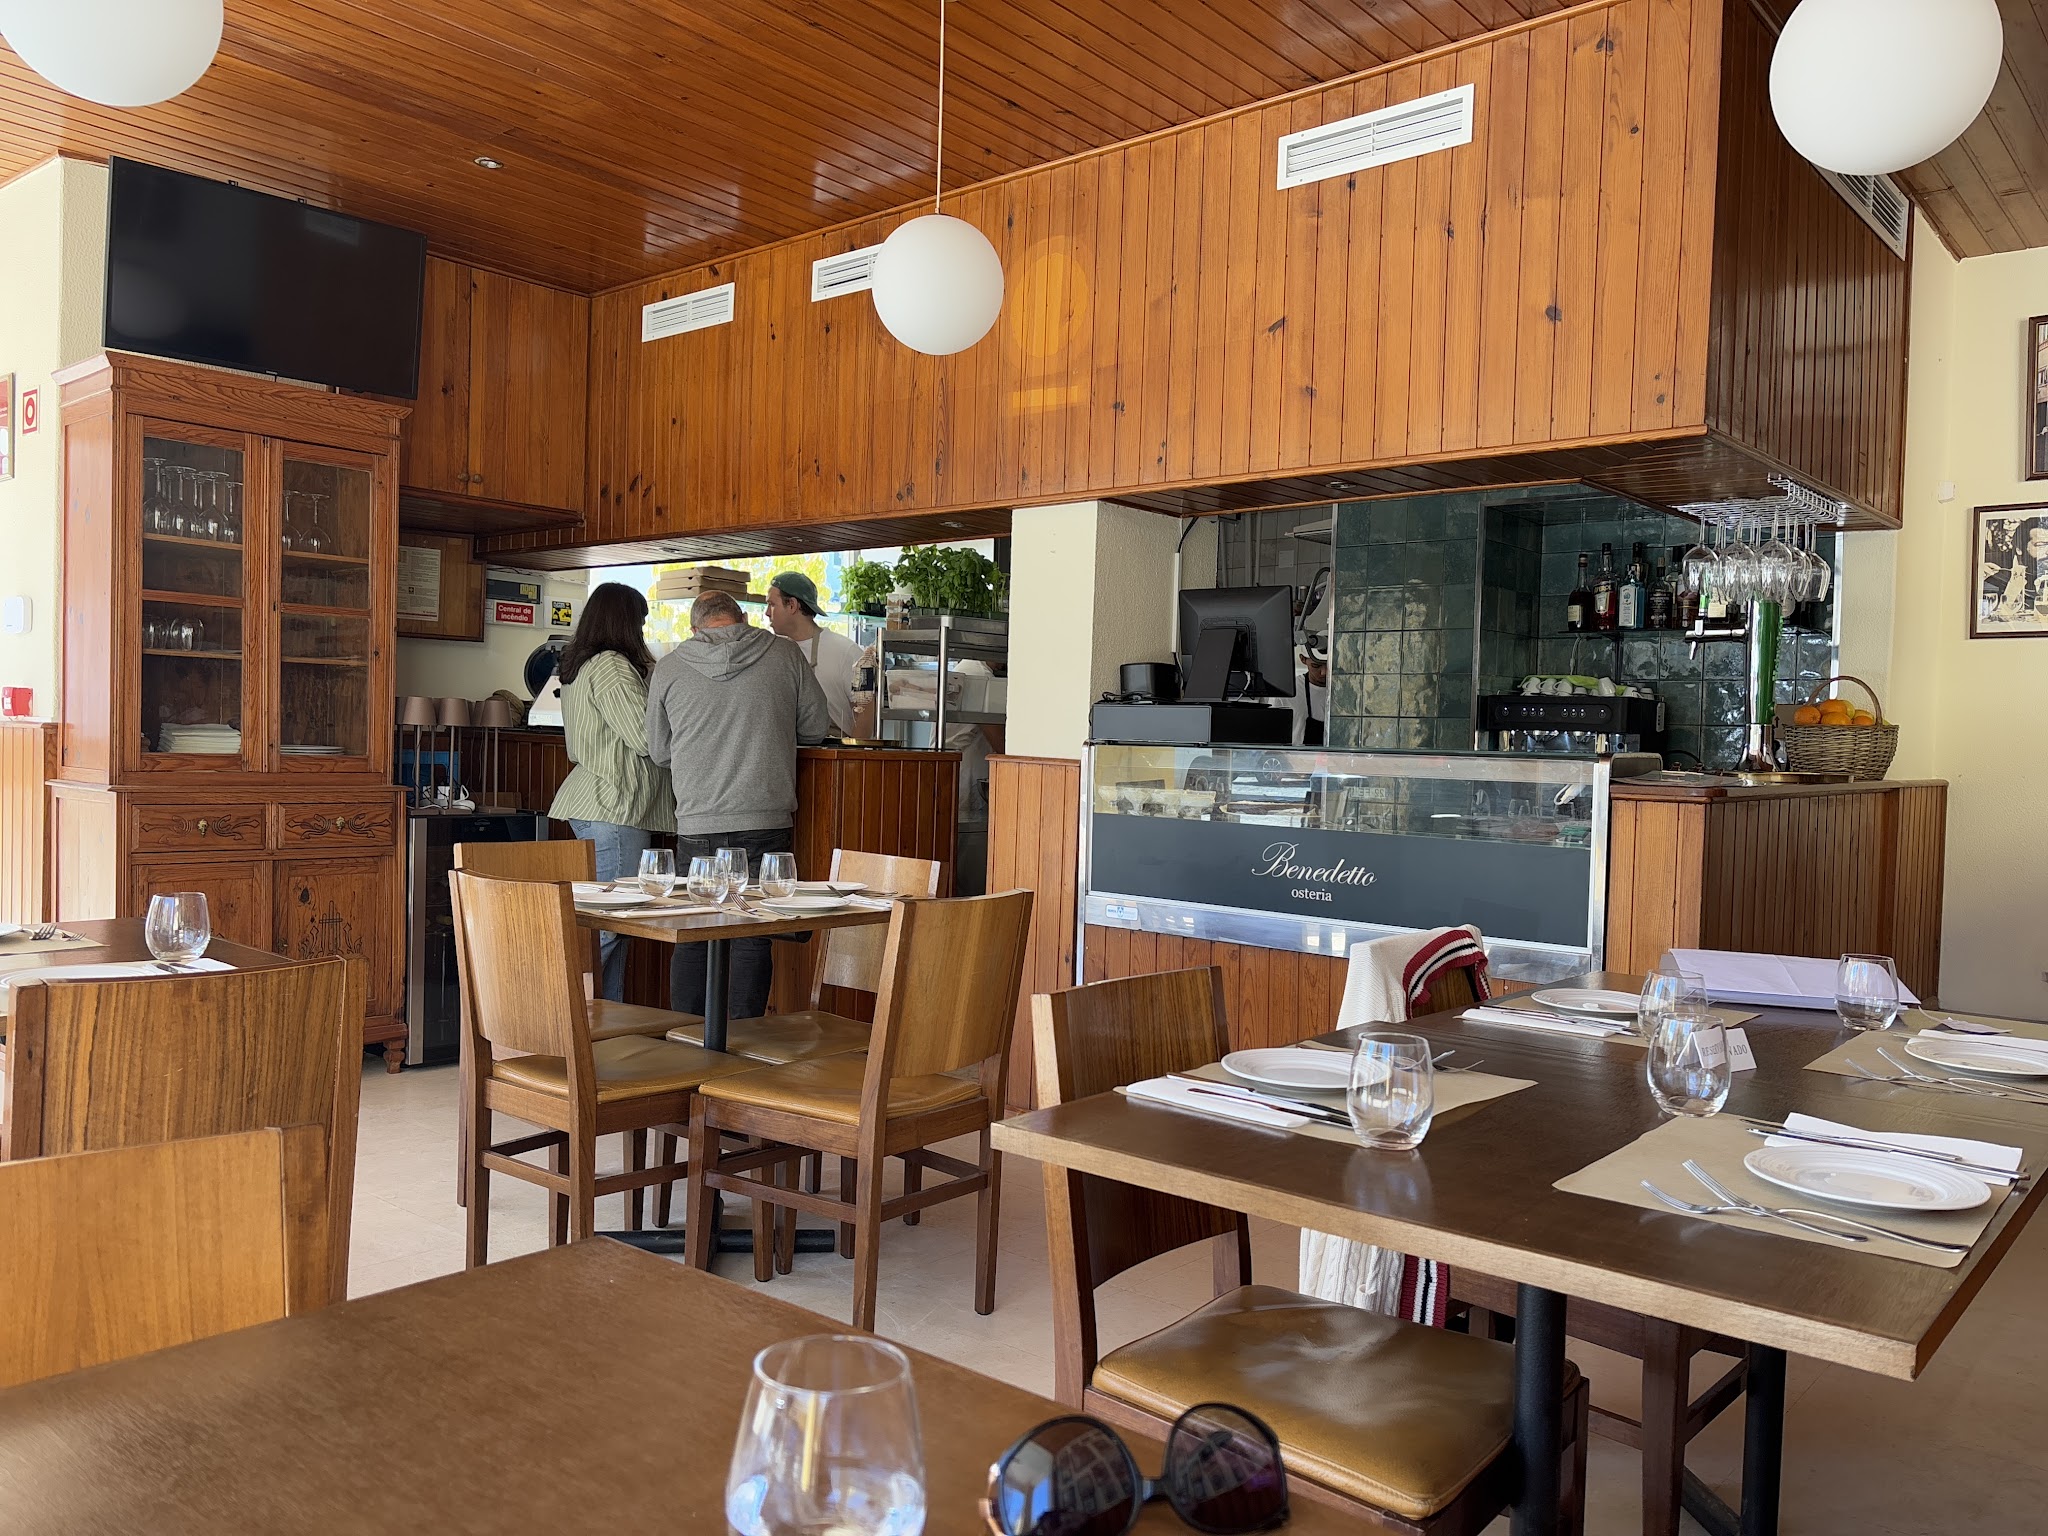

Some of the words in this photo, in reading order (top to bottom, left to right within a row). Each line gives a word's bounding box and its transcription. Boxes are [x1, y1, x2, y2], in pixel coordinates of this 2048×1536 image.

[498, 605, 521, 613] Central
[1251, 842, 1377, 886] Benedetto
[1291, 888, 1332, 901] osteria
